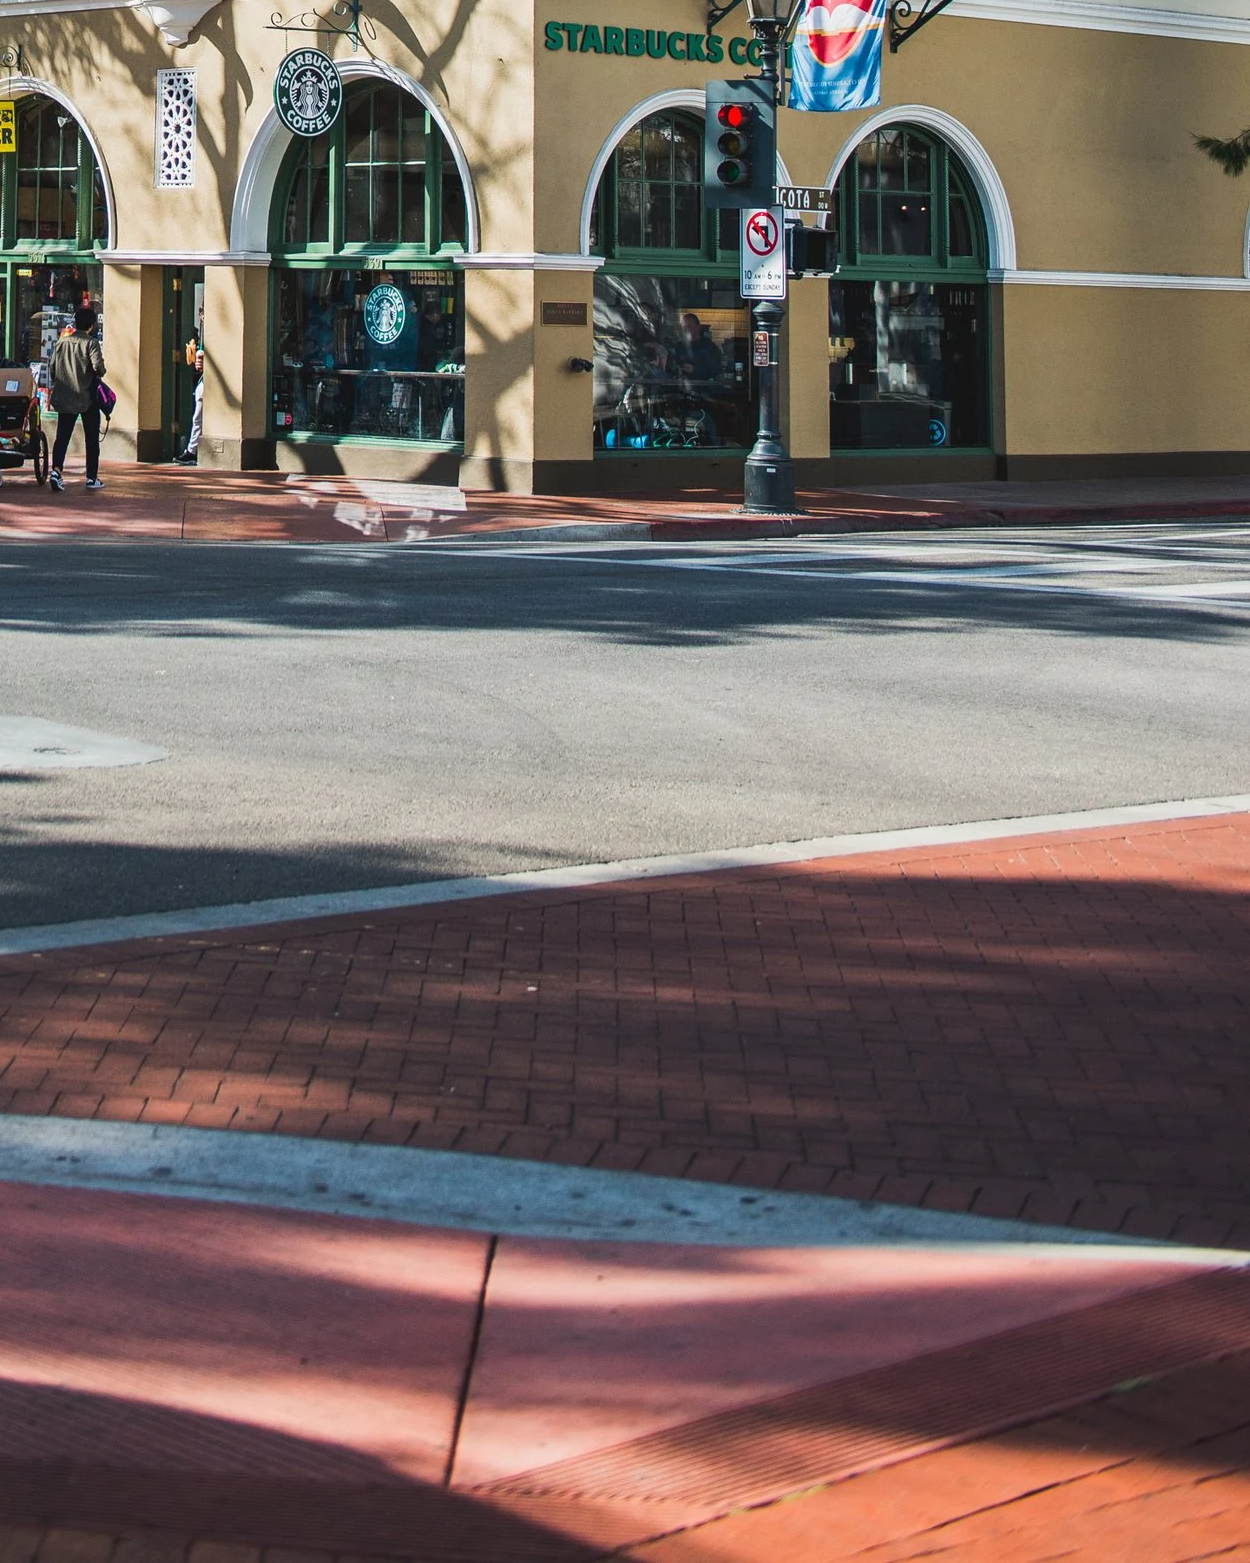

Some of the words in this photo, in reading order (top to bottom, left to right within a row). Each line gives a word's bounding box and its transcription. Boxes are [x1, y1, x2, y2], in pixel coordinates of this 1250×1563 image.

[545, 20, 724, 63] STARBUCKS
[279, 52, 338, 89] STARBUCKS
[287, 109, 331, 132] COFFEE
[779, 189, 810, 209] COTA
[744, 270, 752, 279] 10
[767, 270, 772, 279] 6
[366, 287, 403, 312] STARBUCKS
[369, 326, 398, 341] COFFEE
